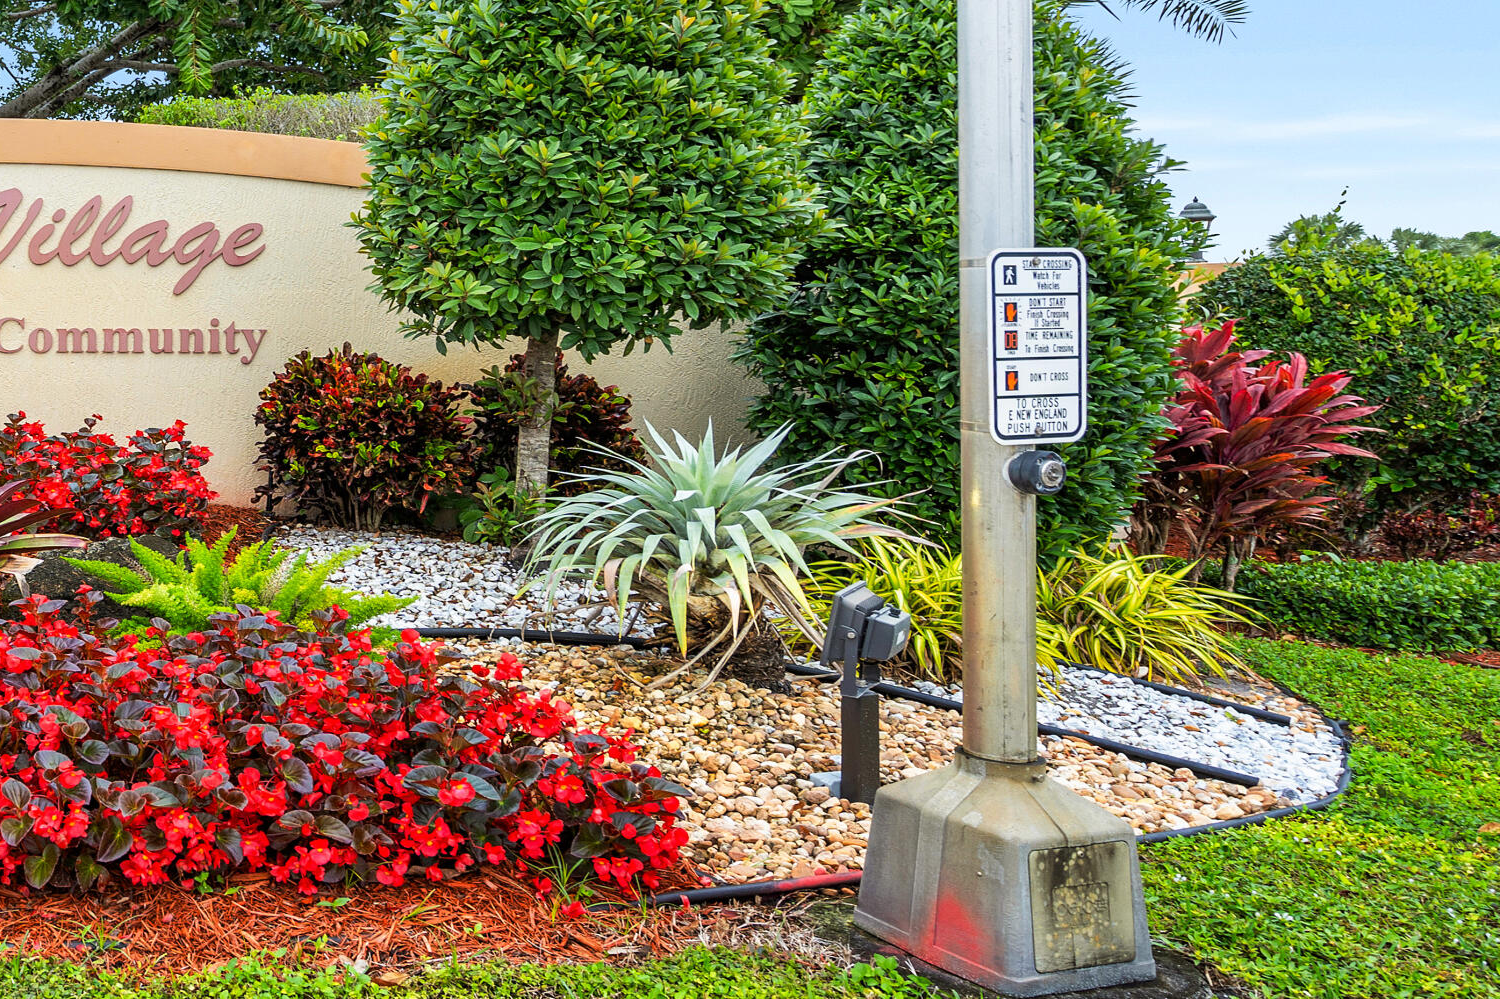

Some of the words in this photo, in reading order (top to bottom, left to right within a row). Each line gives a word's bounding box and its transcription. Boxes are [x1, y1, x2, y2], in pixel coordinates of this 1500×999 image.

[1022, 259, 1040, 268] STA
[1043, 259, 1073, 268] CROSSING
[1033, 271, 1049, 280] Watch
[1053, 271, 1061, 279] For
[1037, 282, 1060, 290] Vehicles
[1029, 298, 1046, 307] DON'T
[1049, 298, 1066, 306] START
[1027, 310, 1043, 318] Finish
[1046, 309, 1069, 320] Crossing
[1041, 318, 1060, 327] Started
[1025, 331, 1038, 340] TIME
[1042, 330, 1073, 339] REMAINING
[1025, 345, 1031, 353] To
[1034, 345, 1049, 353] Finish
[1053, 344, 1074, 354] Crossing
[1030, 373, 1047, 381] DON'T
[1050, 372, 1068, 381] CROSS
[1017, 399, 1026, 408] TO
[1031, 397, 1059, 408] CROSS
[1009, 410, 1013, 421] E
[1016, 409, 1031, 420] NEW
[1035, 408, 1067, 419] ENGLAND
[1008, 423, 1030, 433] PUSH
